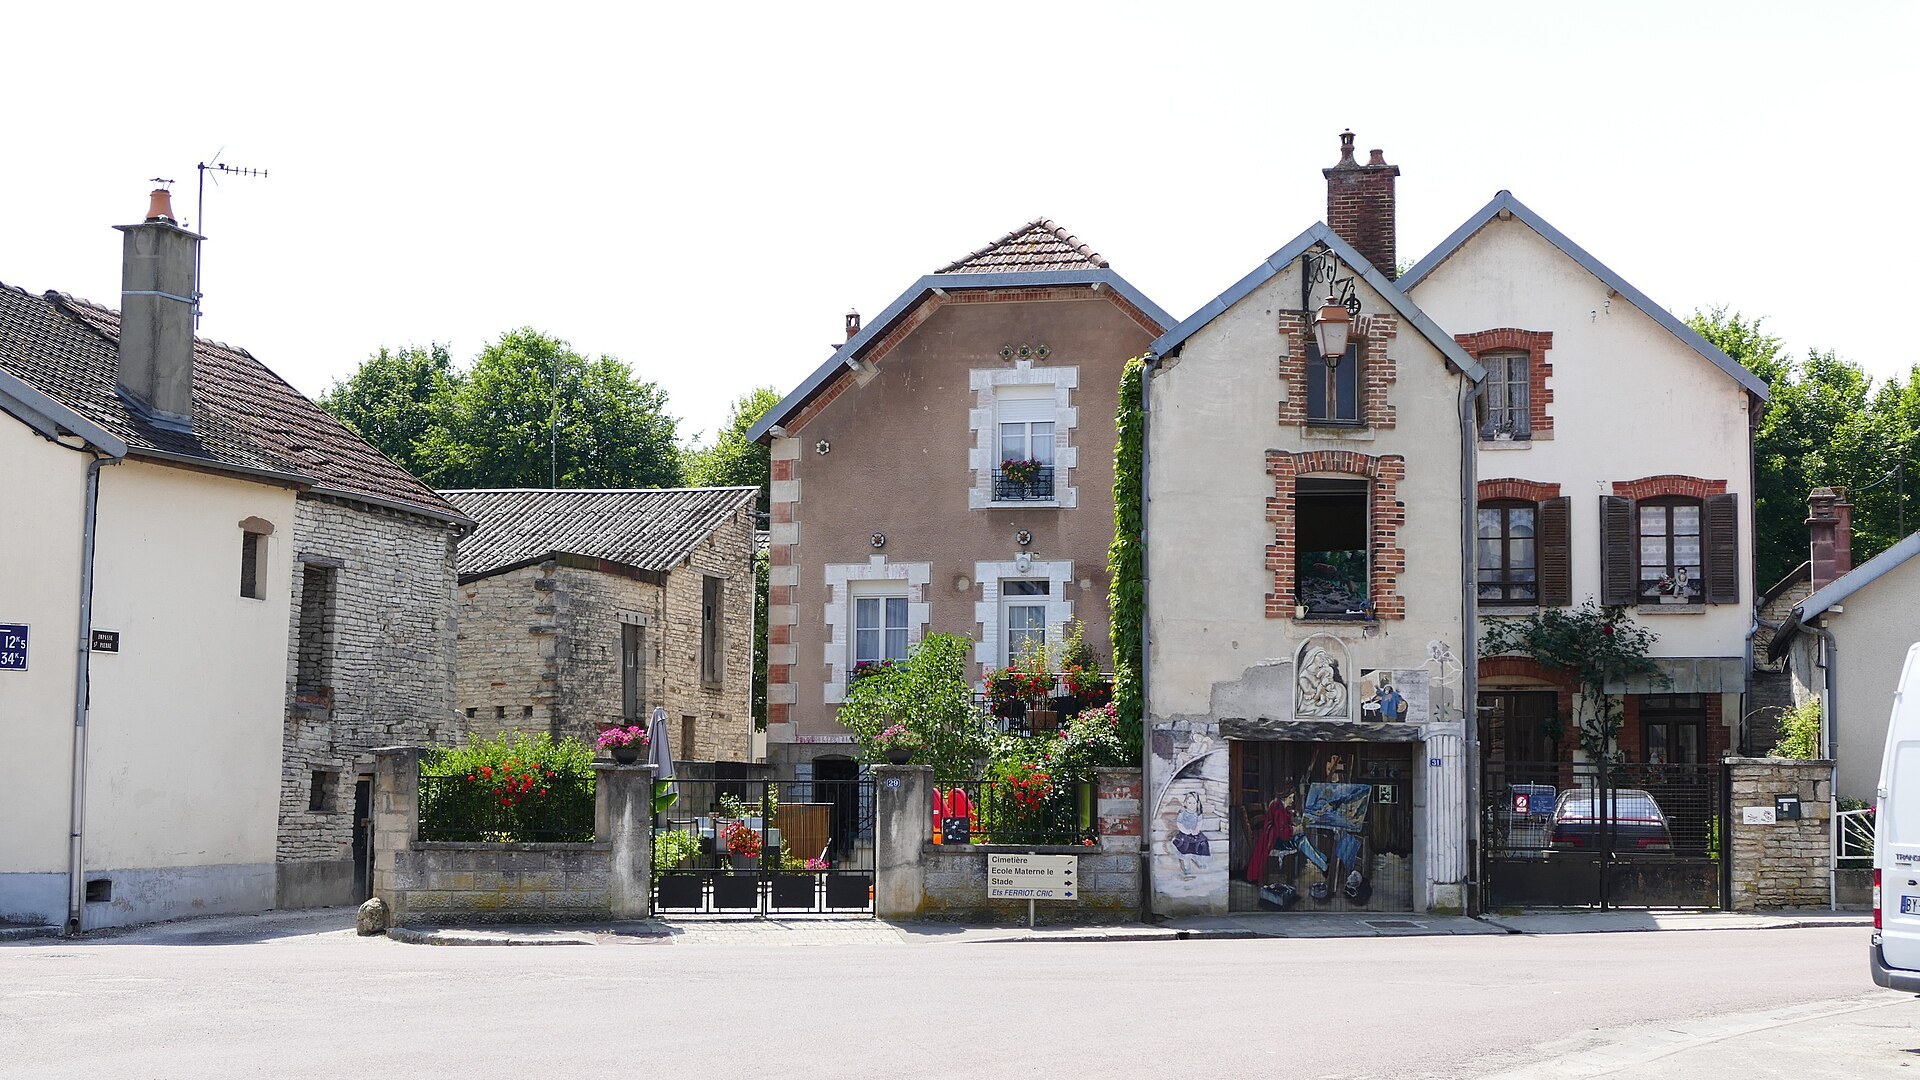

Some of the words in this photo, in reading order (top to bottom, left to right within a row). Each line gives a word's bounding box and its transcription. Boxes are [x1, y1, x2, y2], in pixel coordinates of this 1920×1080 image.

[888, 779, 899, 787] 29
[991, 856, 1028, 864] Cimetière
[991, 867, 1013, 875] Ecole
